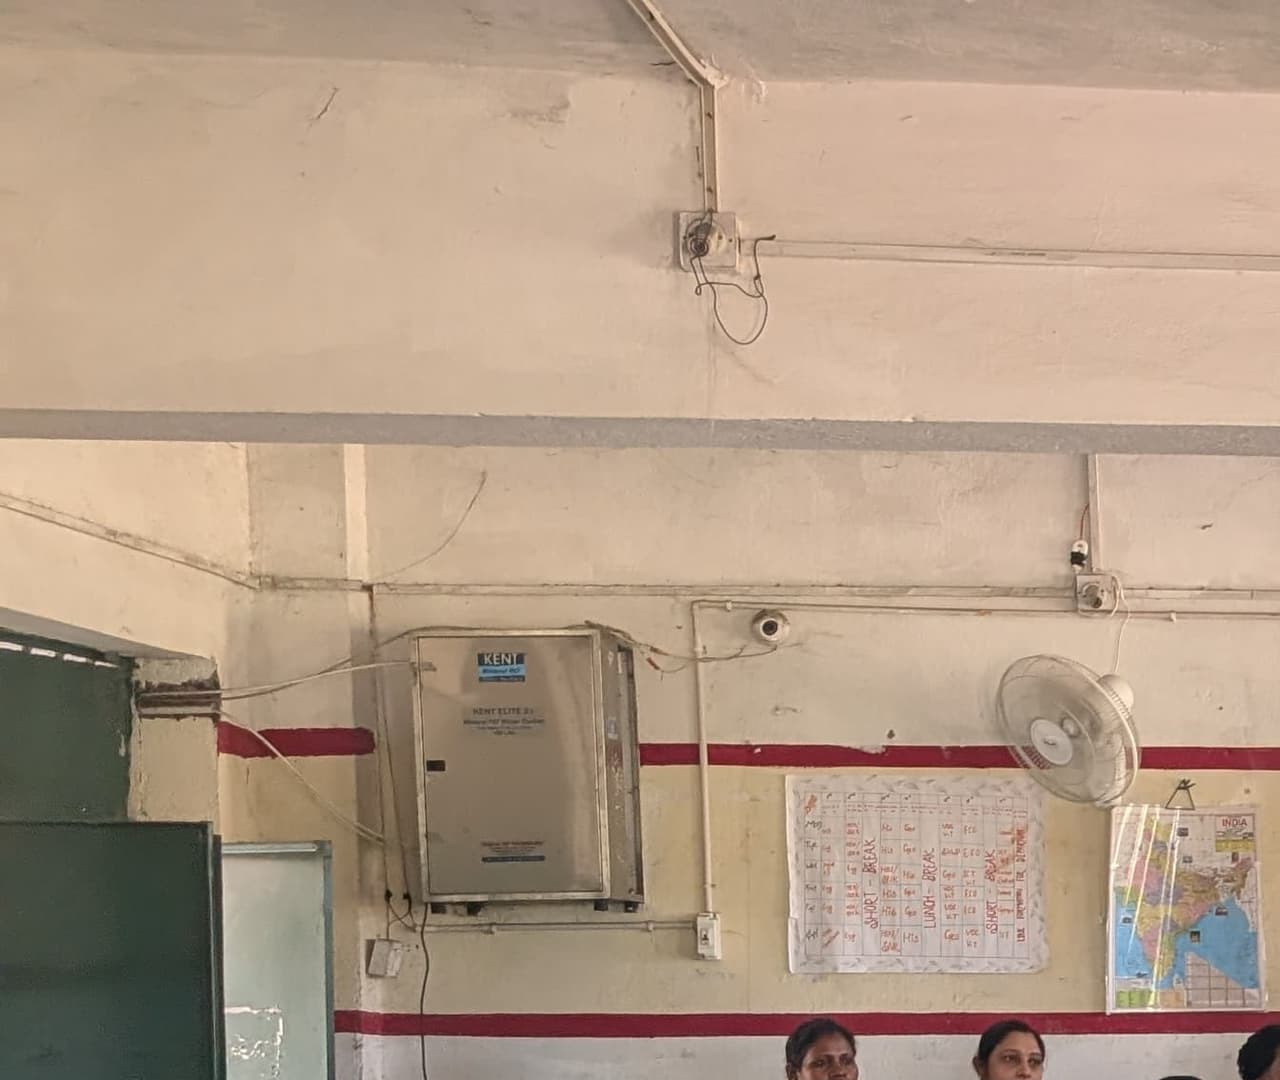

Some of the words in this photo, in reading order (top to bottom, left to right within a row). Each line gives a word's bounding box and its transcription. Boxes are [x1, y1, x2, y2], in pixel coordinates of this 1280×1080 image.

[484, 653, 518, 665] KENT
[1222, 818, 1247, 828] INDIA
[923, 895, 937, 929] LUNCH
